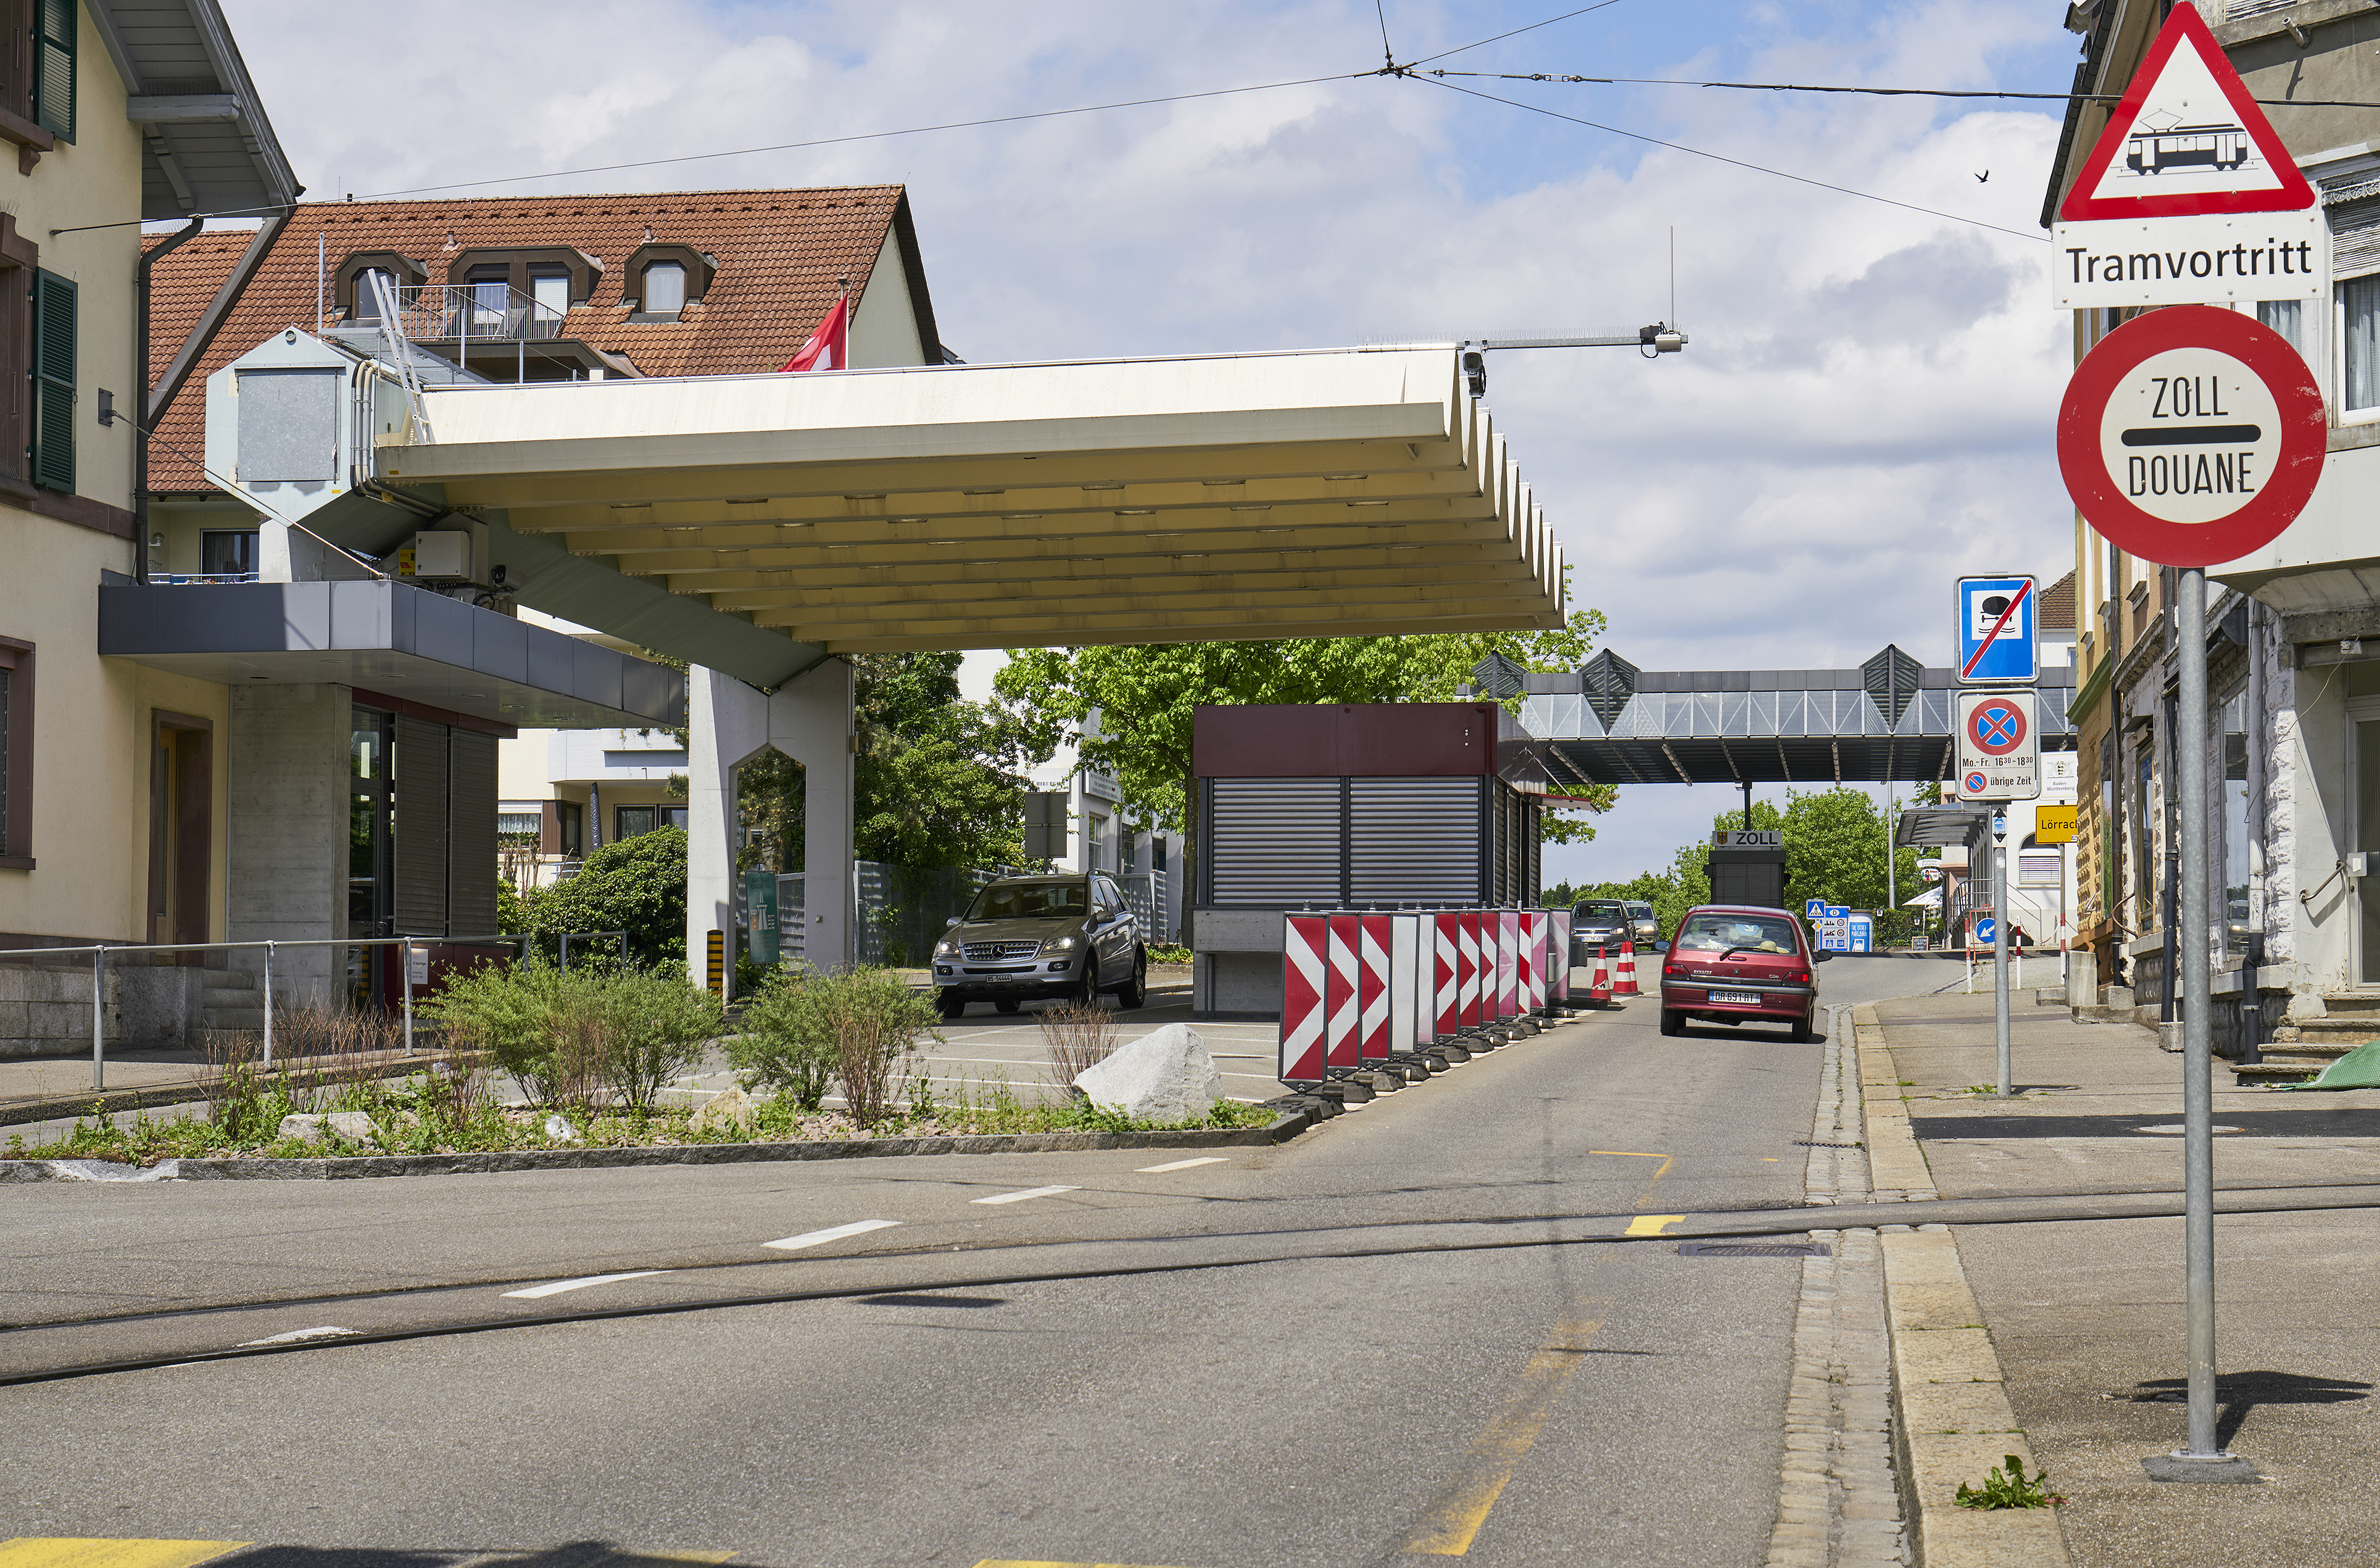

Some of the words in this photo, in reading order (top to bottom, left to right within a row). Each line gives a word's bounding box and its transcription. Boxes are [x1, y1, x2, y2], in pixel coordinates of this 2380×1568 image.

[2065, 237, 2312, 283] Tramvortritt
[2152, 376, 2229, 418] ZOLL
[2129, 452, 2255, 496] DOUANE
[1990, 776, 2014, 787] übrige
[2017, 776, 2031, 785] Zeit
[1736, 832, 1778, 845] ZOLL
